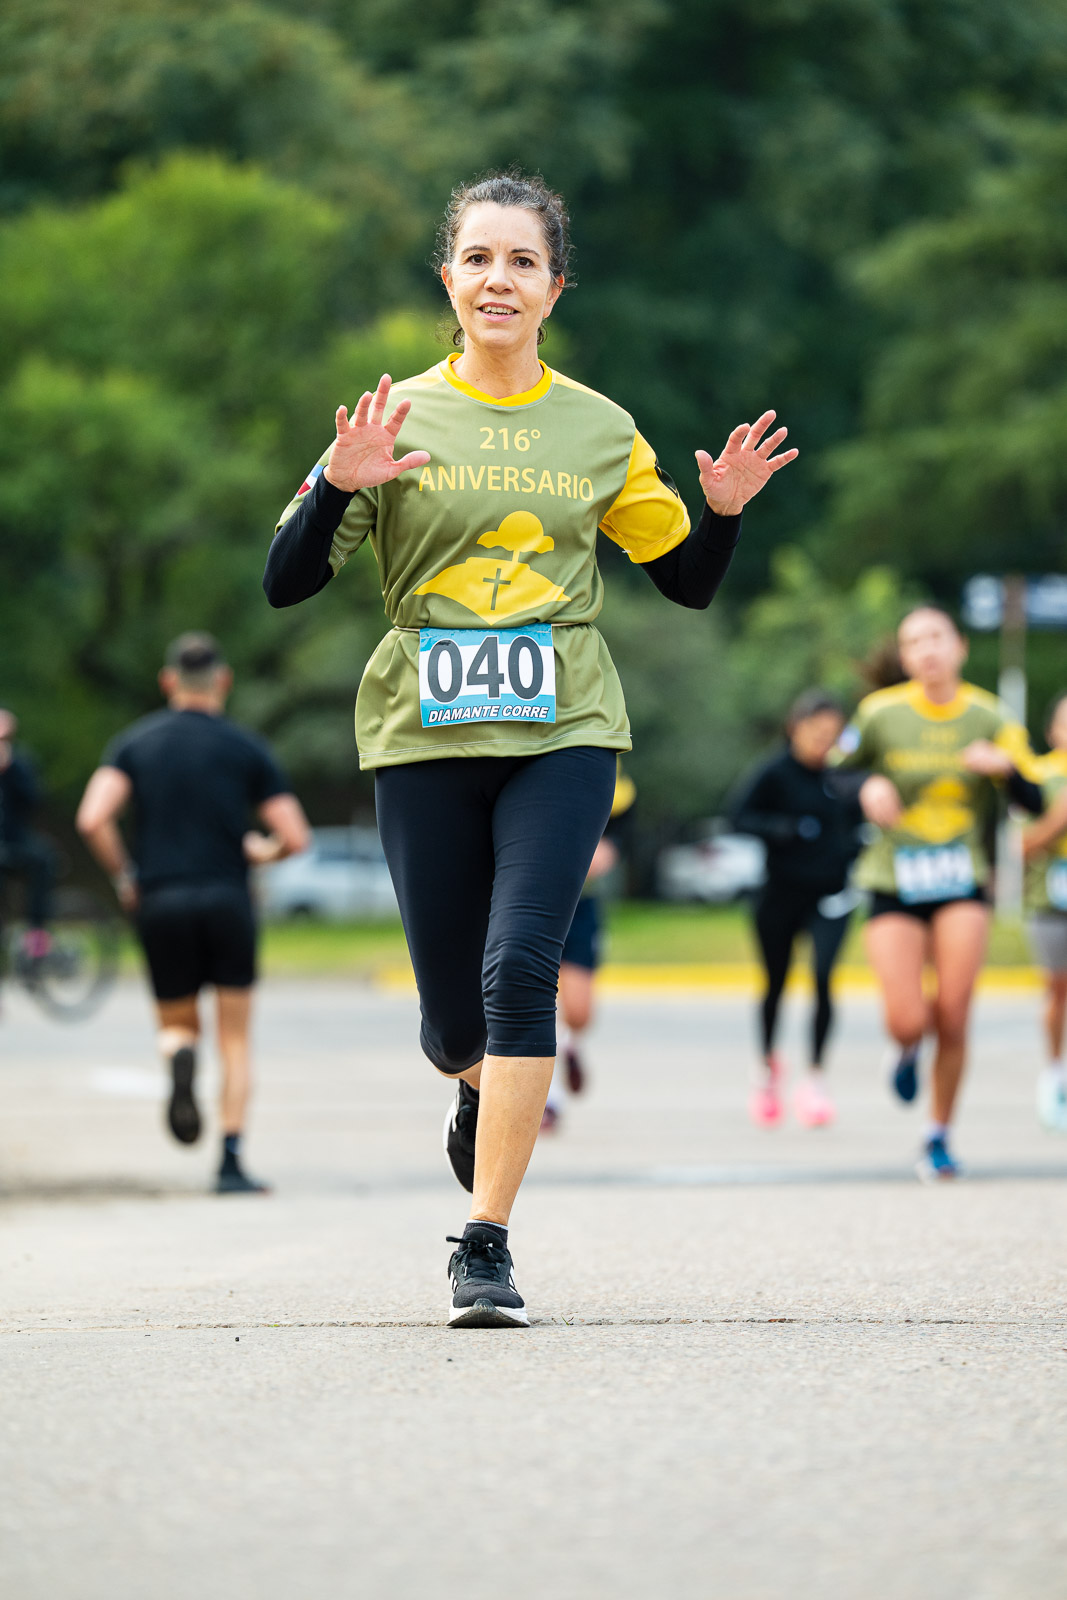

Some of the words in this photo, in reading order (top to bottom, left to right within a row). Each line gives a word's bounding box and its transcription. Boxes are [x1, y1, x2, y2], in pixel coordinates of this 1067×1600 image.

[479, 426, 542, 452] 216°
[418, 465, 595, 502] ANIVERSARIO
[427, 635, 544, 703] 040
[428, 705, 501, 723] DIAMANTE
[502, 705, 550, 719] CORRE
